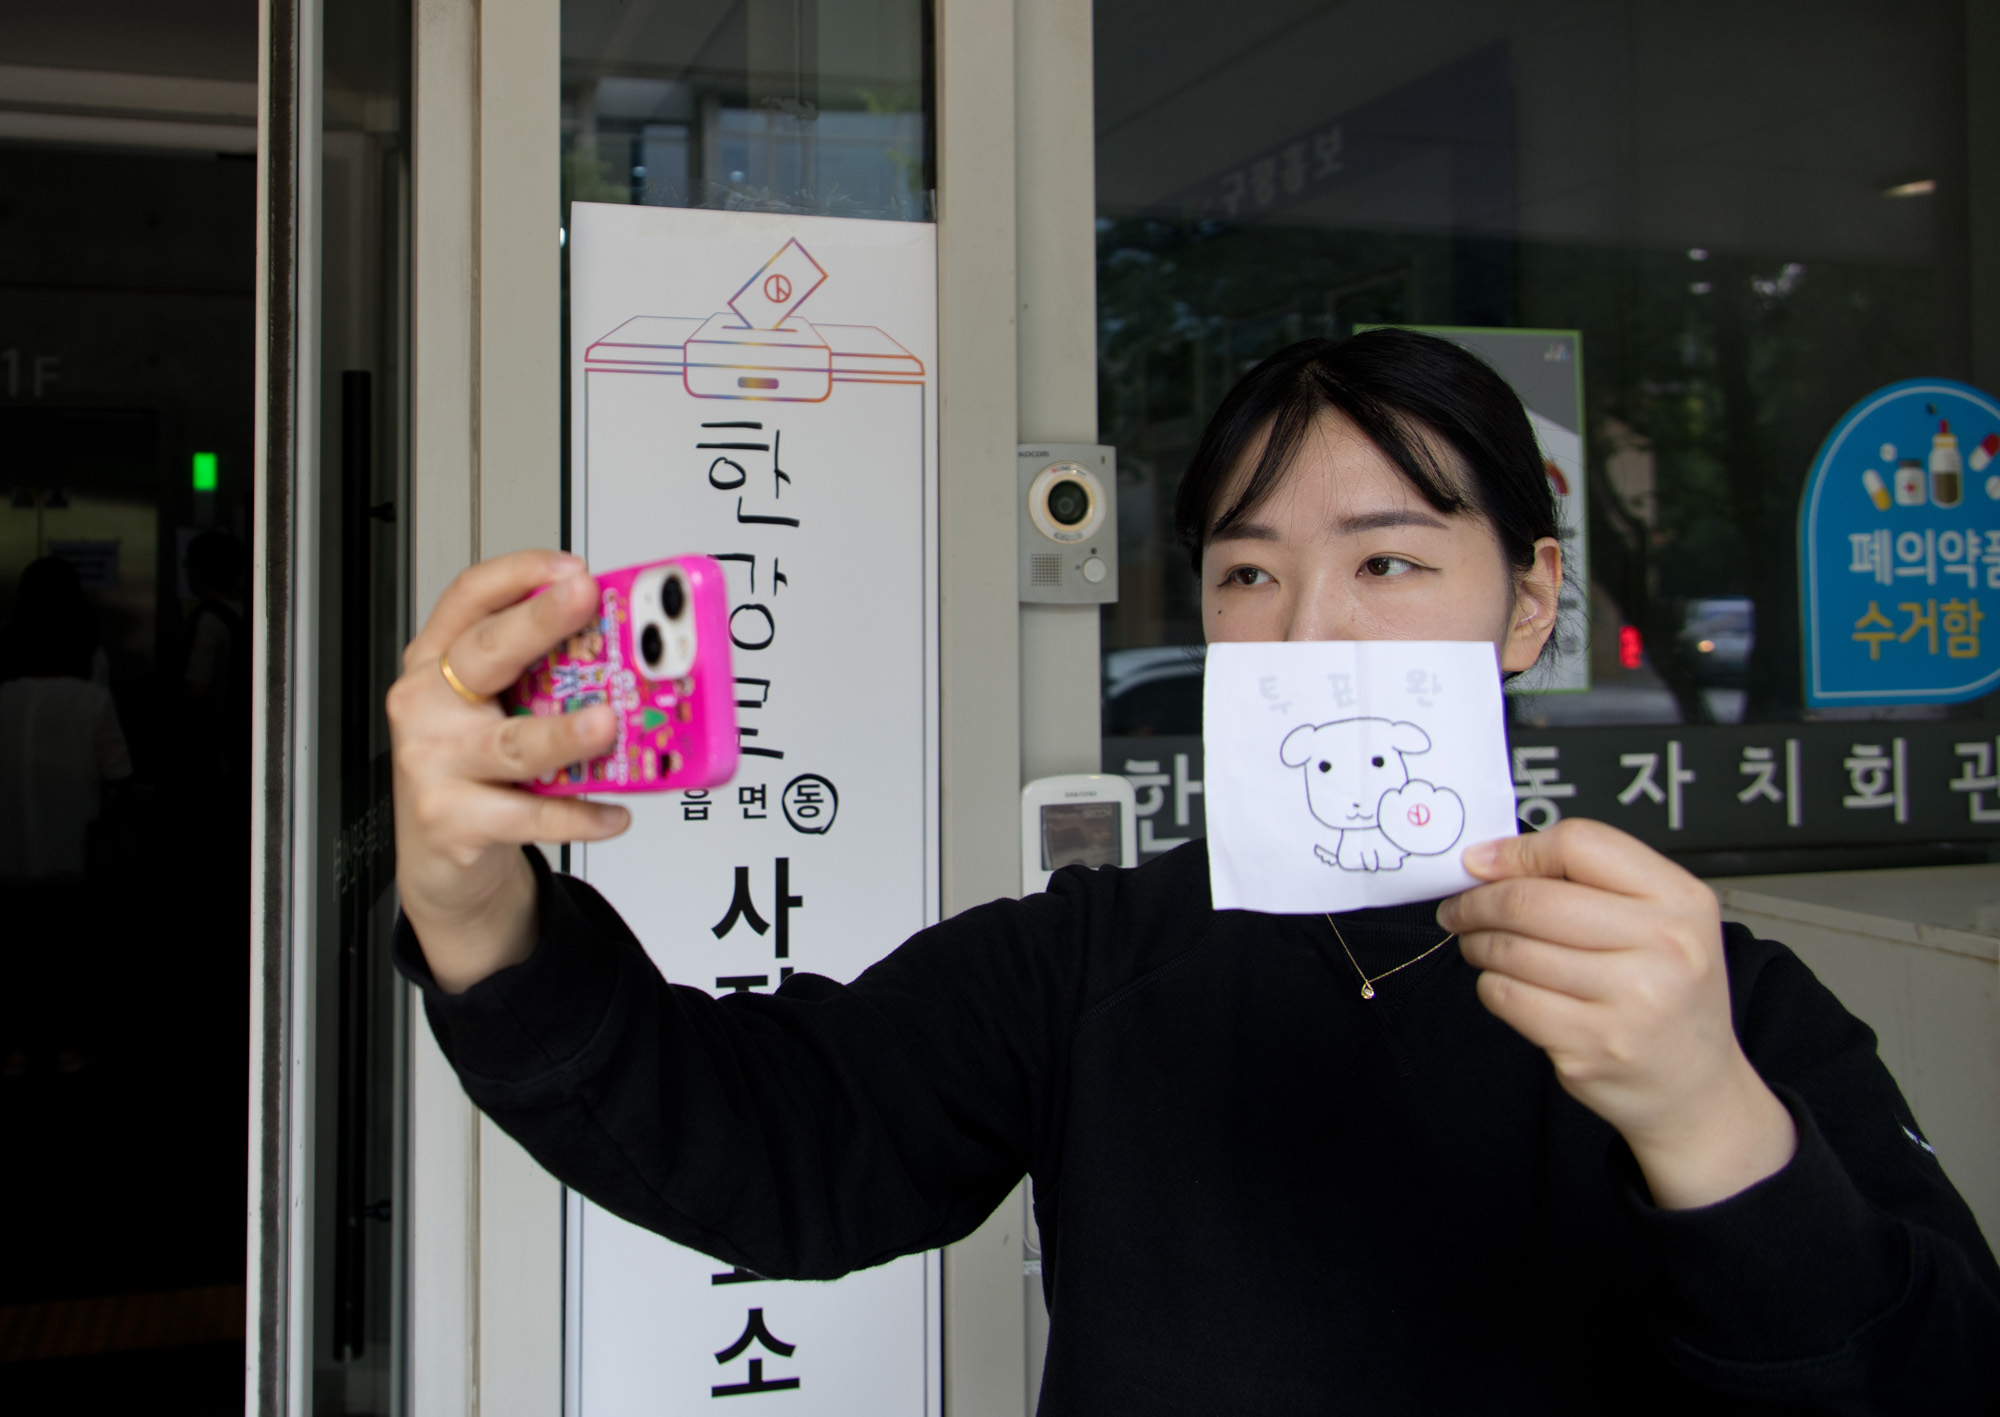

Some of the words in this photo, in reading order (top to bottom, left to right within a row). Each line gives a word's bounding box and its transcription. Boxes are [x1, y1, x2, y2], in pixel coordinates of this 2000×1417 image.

[1852, 598, 1985, 661] 수거함
[738, 783, 768, 819] 면
[793, 783, 825, 819] 동
